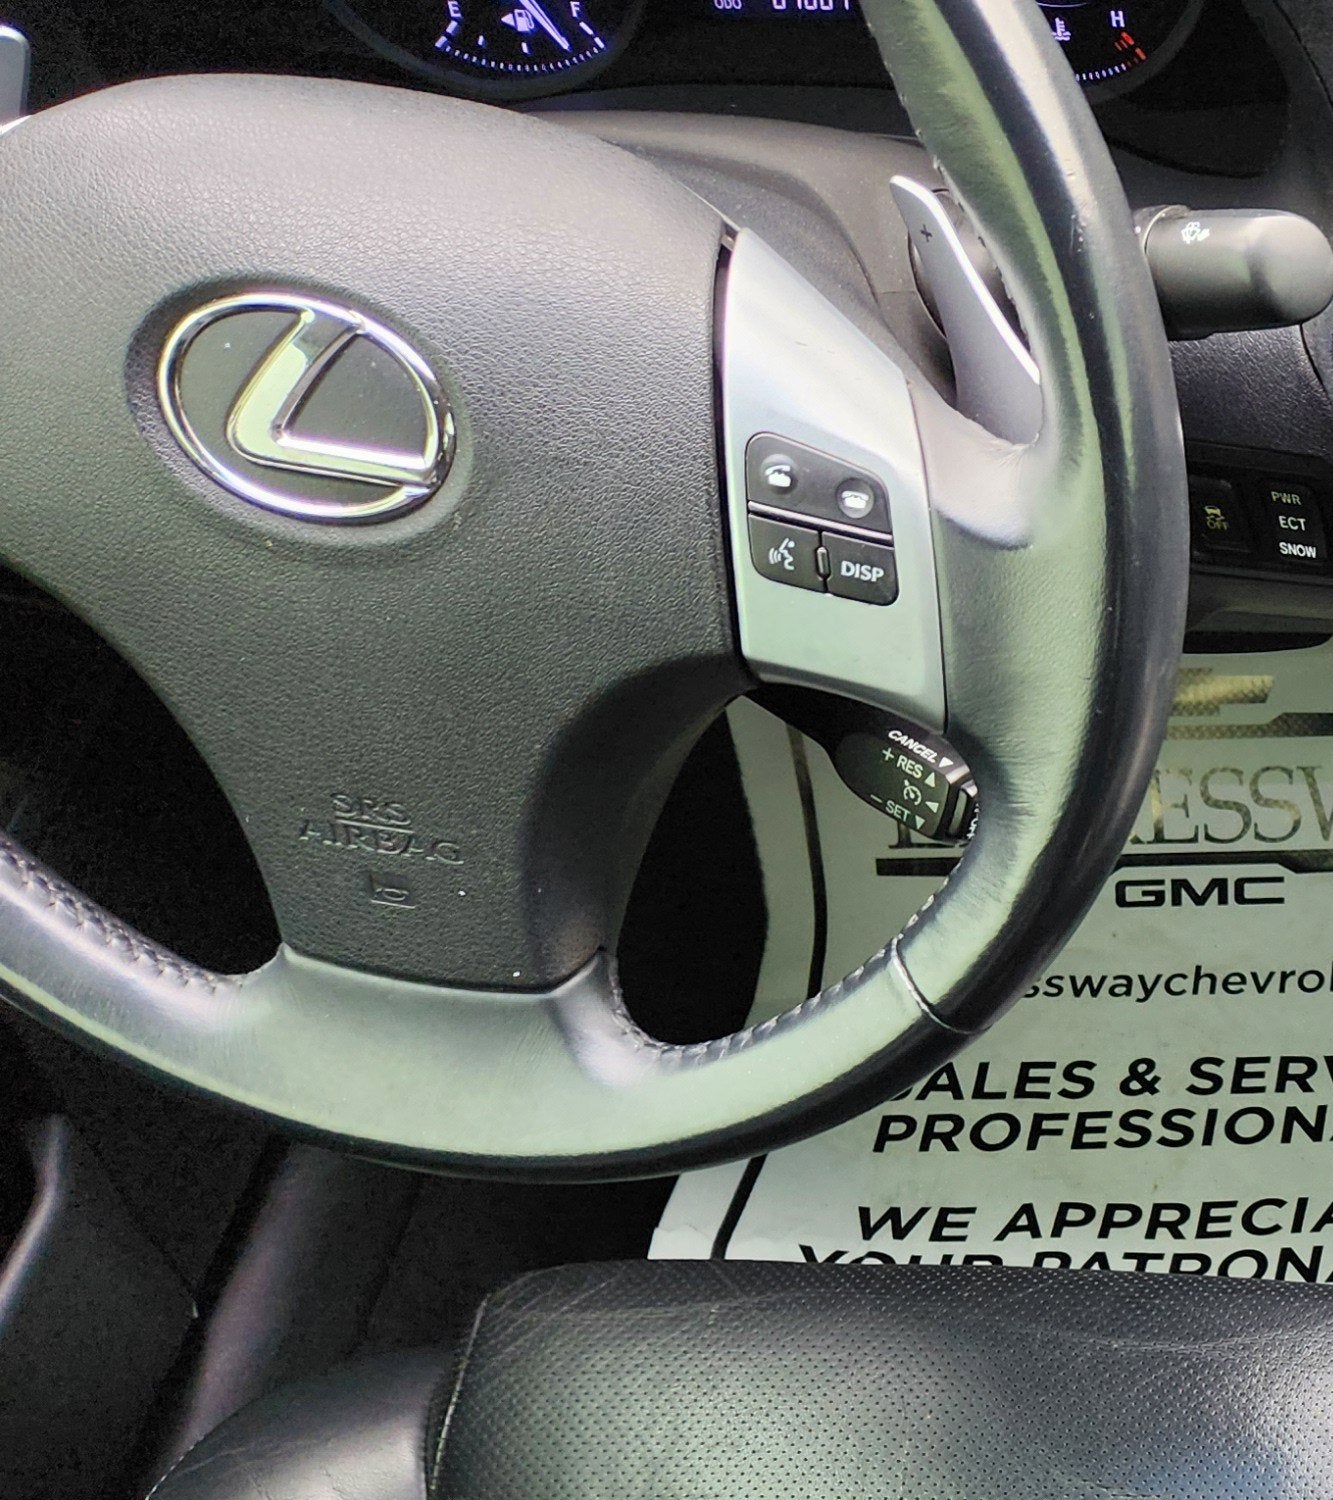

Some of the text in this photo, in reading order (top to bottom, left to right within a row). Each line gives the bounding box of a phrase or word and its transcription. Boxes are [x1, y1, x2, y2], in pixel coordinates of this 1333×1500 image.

[1110, 10, 1125, 28] H
[1271, 491, 1301, 505] PWR
[1279, 516, 1306, 531] ECT
[1279, 542, 1317, 558] SNOW
[840, 559, 884, 582] DISP
[888, 730, 937, 763] CANCEL
[897, 754, 923, 779] RES
[885, 800, 912, 822] SET
[1115, 876, 1285, 908] GMC
[1119, 1058, 1161, 1097] &
[857, 1205, 978, 1243] WE
